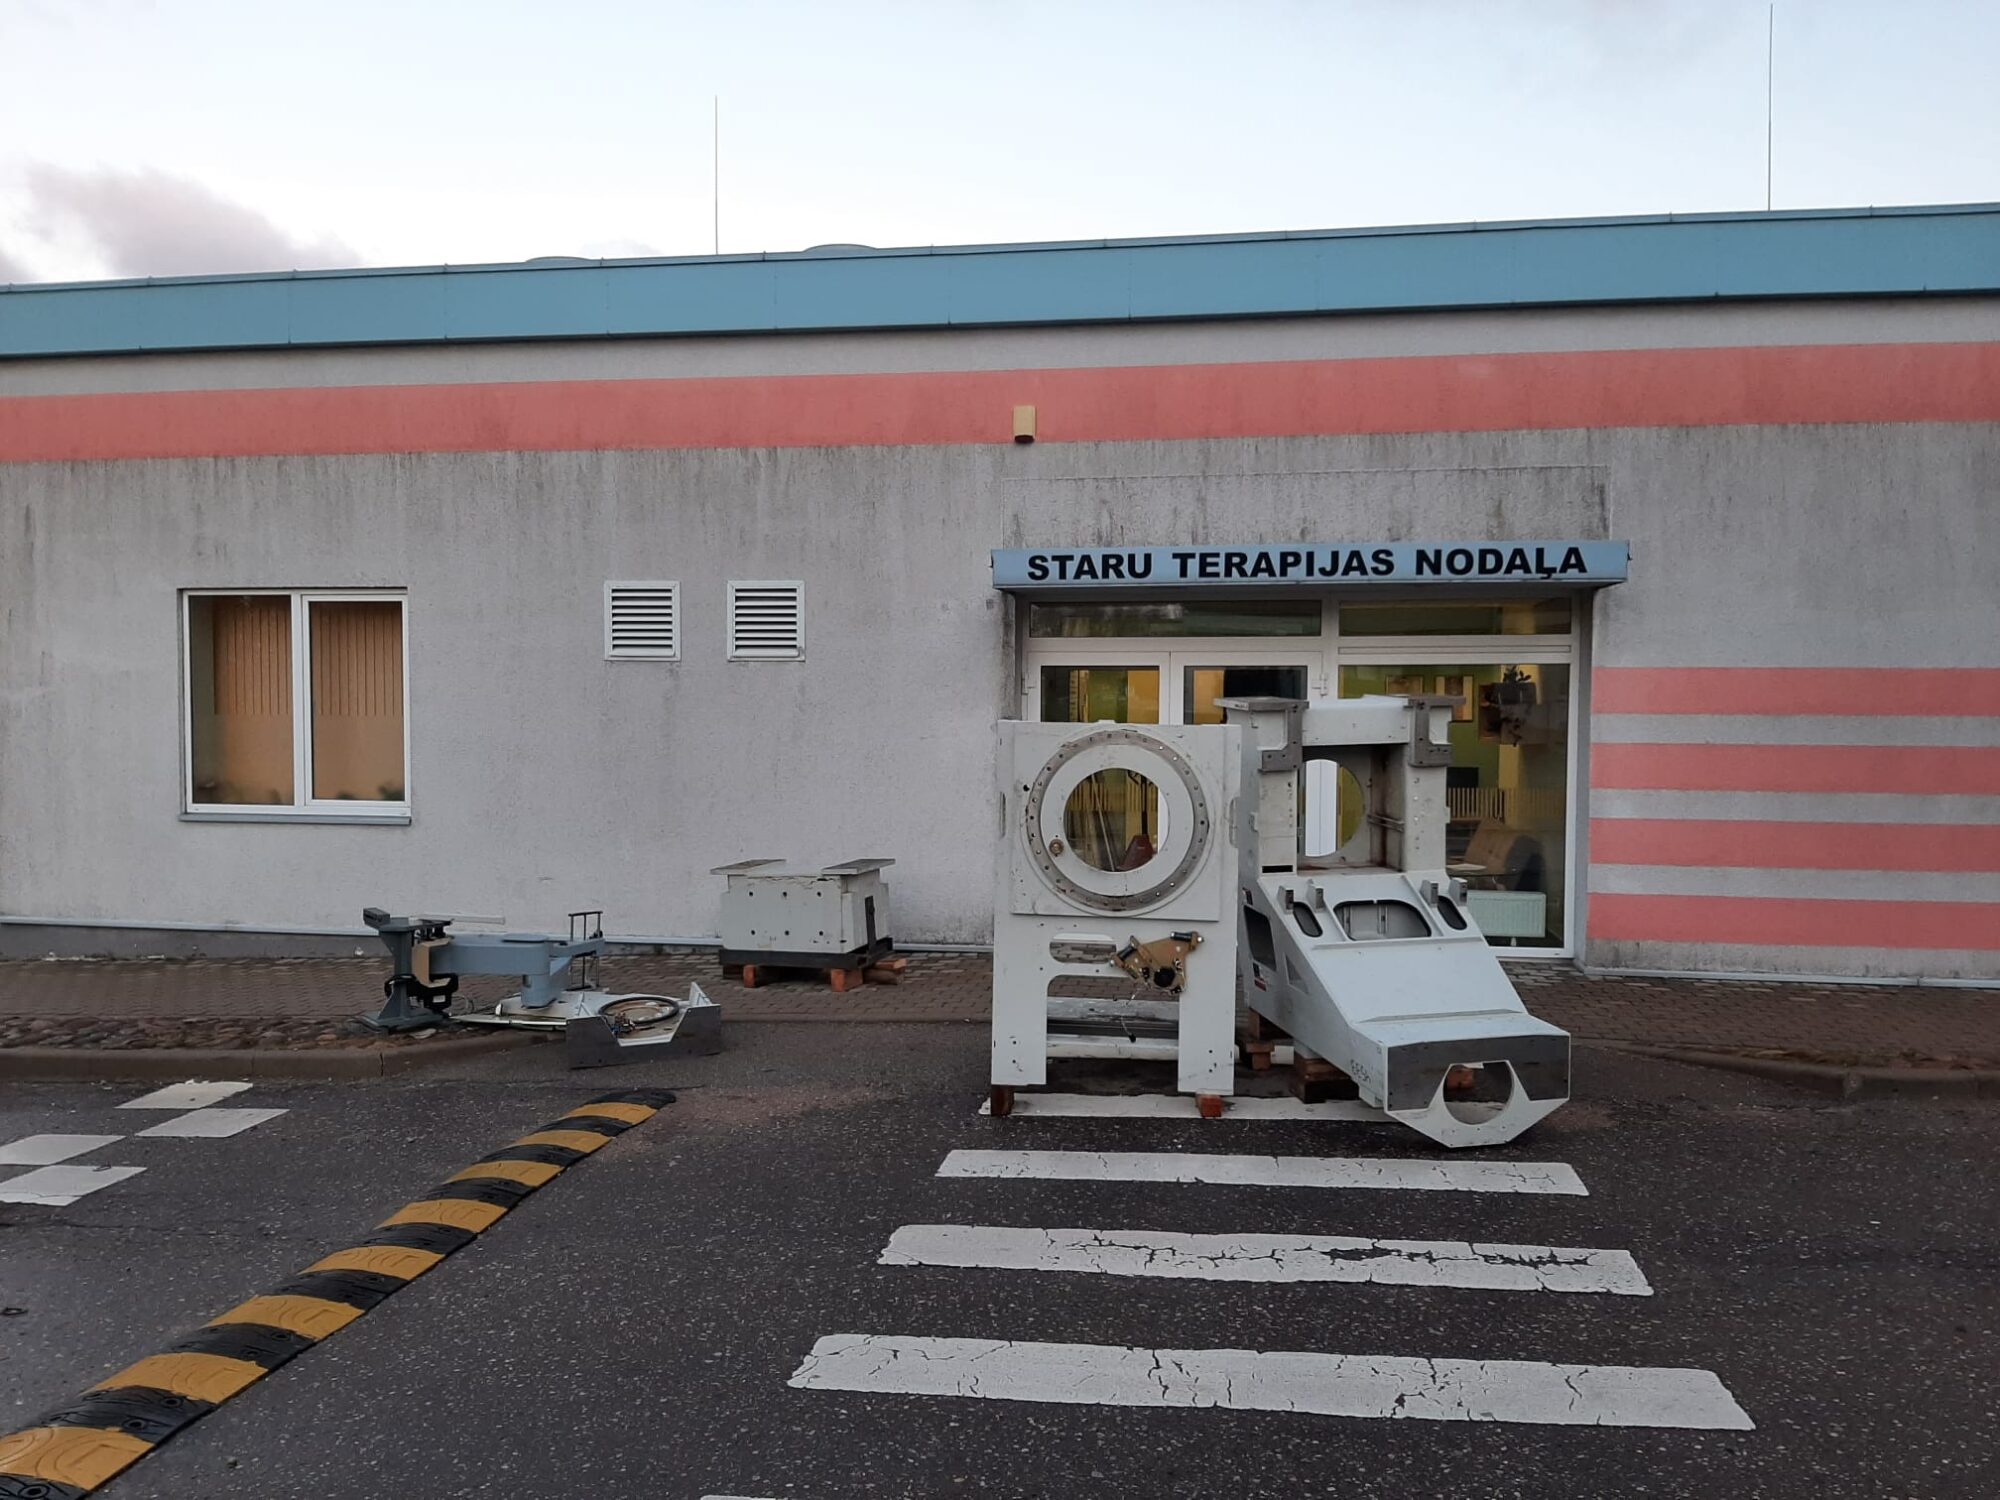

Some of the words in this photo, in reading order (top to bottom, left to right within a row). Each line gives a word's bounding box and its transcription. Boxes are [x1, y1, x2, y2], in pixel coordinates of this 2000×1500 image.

[1027, 553, 1152, 581] STARU
[1171, 549, 1395, 579] TERAPIJAS
[1415, 546, 1588, 580] NODAĻA
